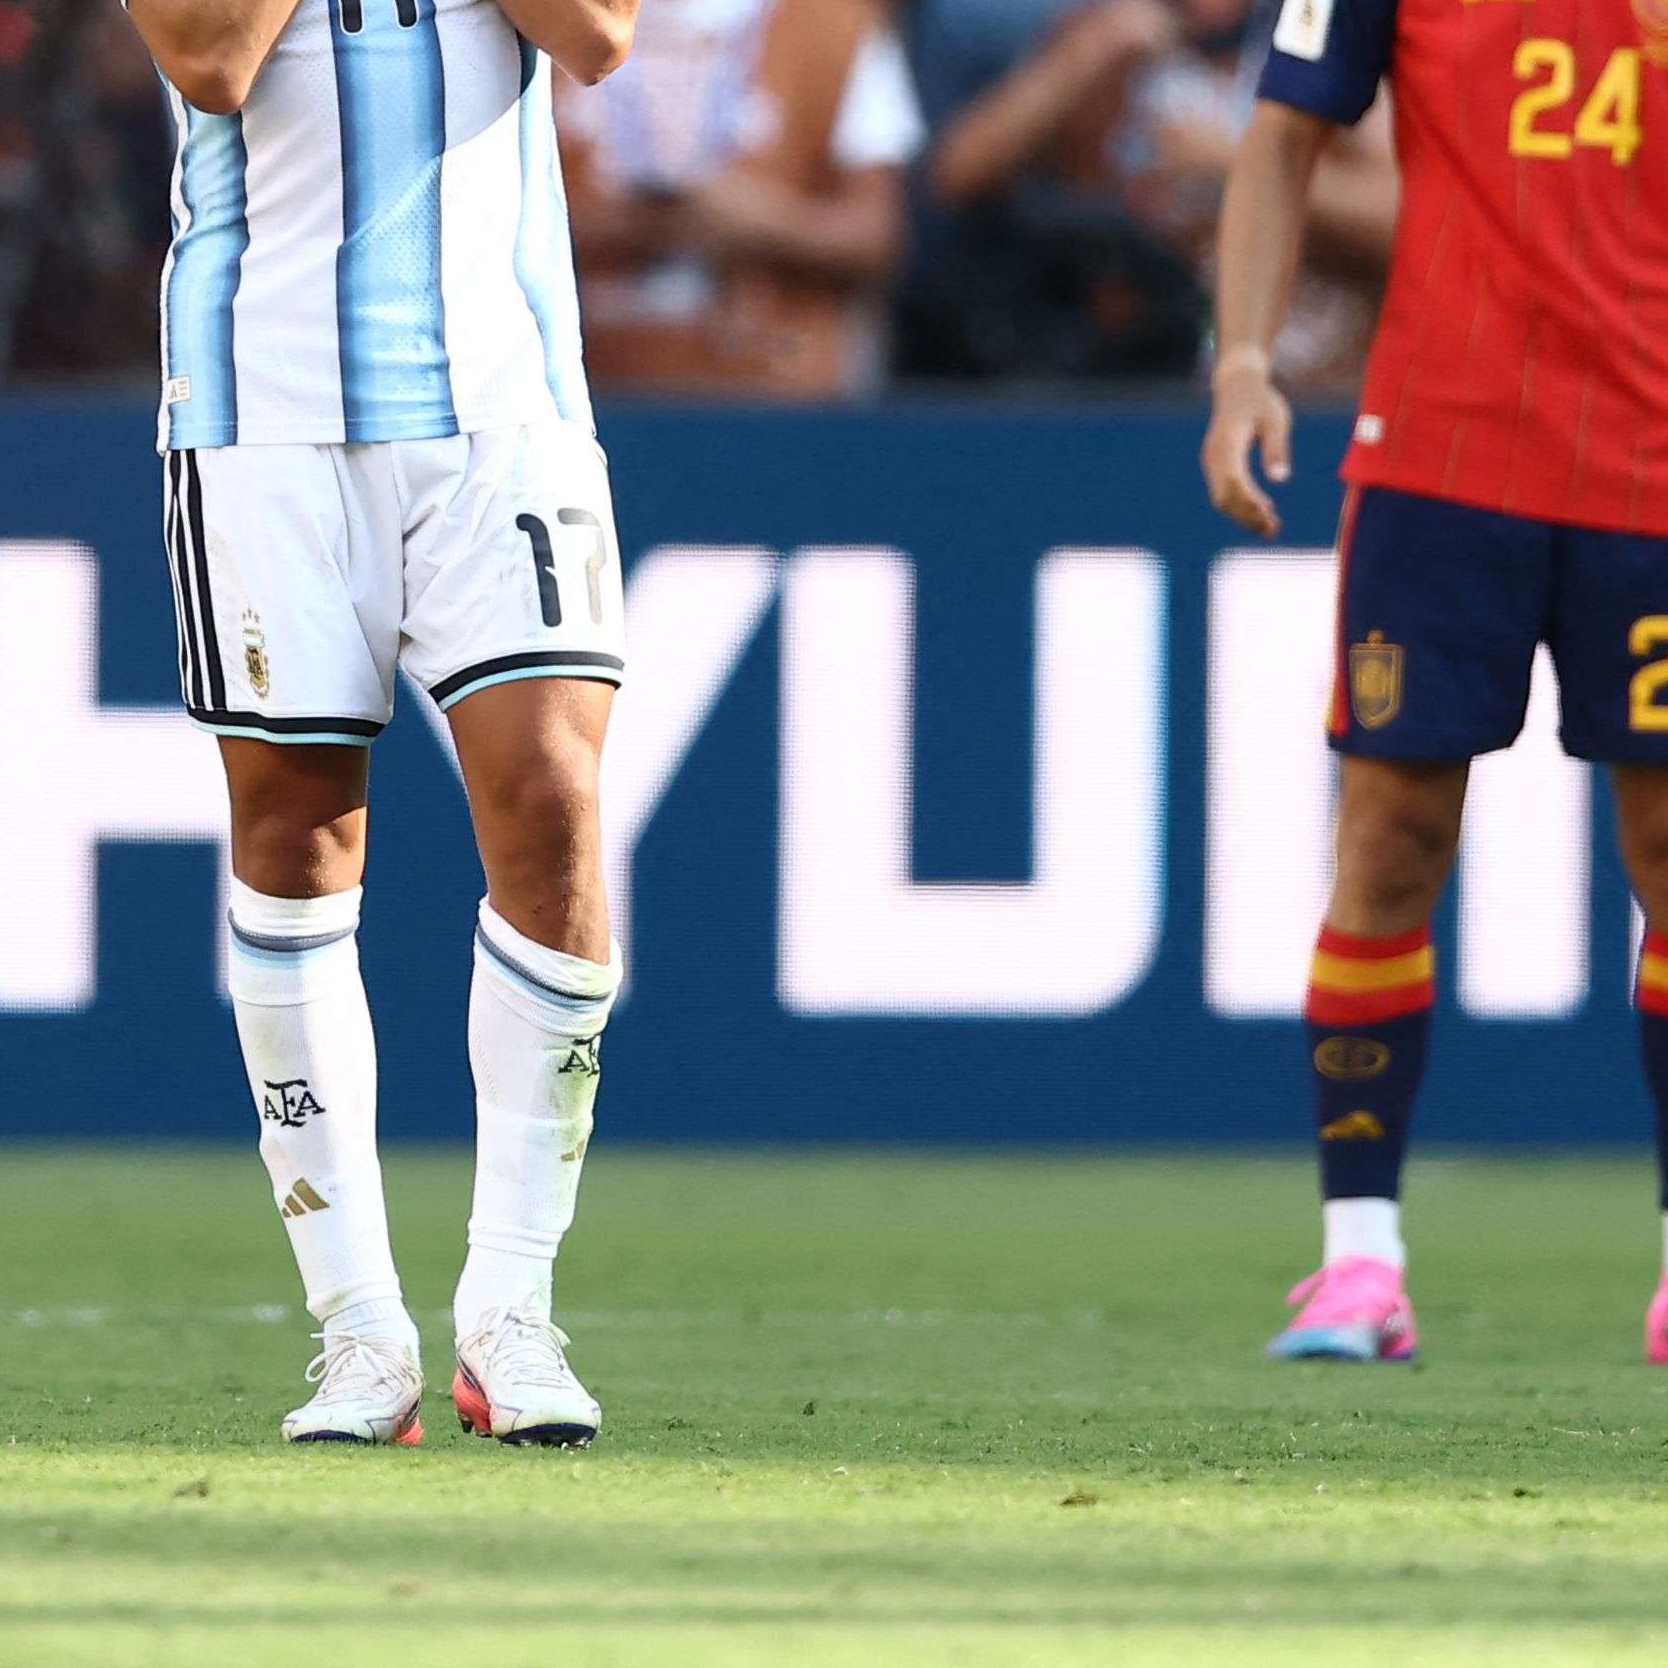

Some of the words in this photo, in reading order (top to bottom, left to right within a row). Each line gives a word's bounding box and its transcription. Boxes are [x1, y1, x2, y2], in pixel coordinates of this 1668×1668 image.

[1510, 37, 1642, 167] 24
[515, 507, 607, 628] 17
[558, 1033, 601, 1078] AF
[263, 1078, 326, 1128] AFA
